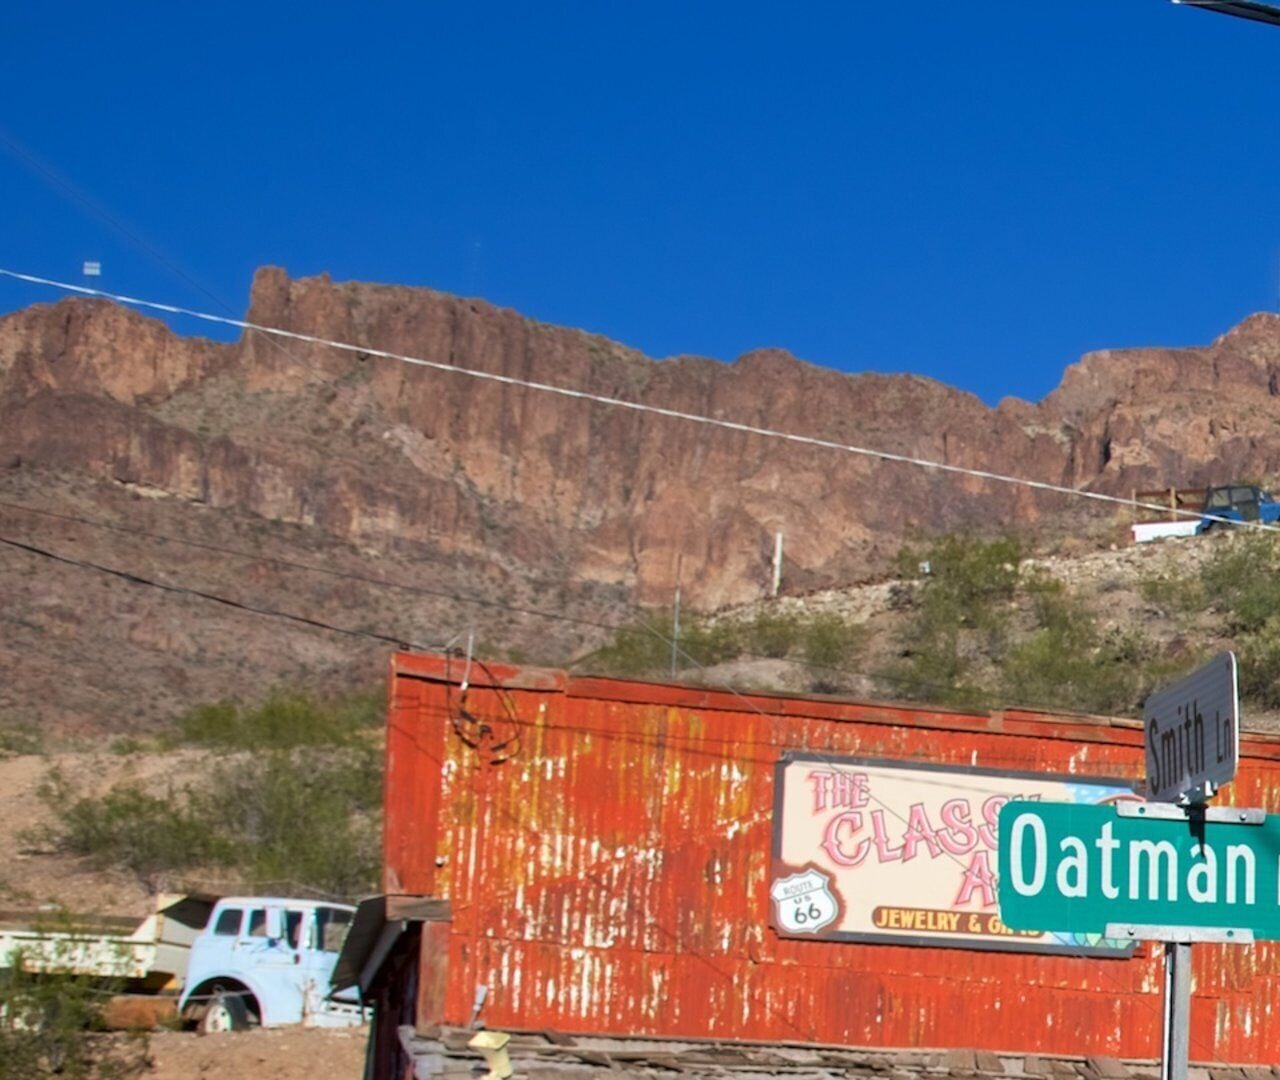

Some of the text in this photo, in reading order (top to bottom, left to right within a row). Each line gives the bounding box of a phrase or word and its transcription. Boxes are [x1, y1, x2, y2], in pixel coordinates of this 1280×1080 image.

[1150, 700, 1232, 796] Smith Ln
[807, 770, 871, 814] THE
[820, 793, 1043, 868] CLASS
[1010, 812, 1256, 905] Oatman
[794, 902, 822, 925] 66
[876, 908, 961, 931] JEWELRY
[967, 915, 983, 933] &
